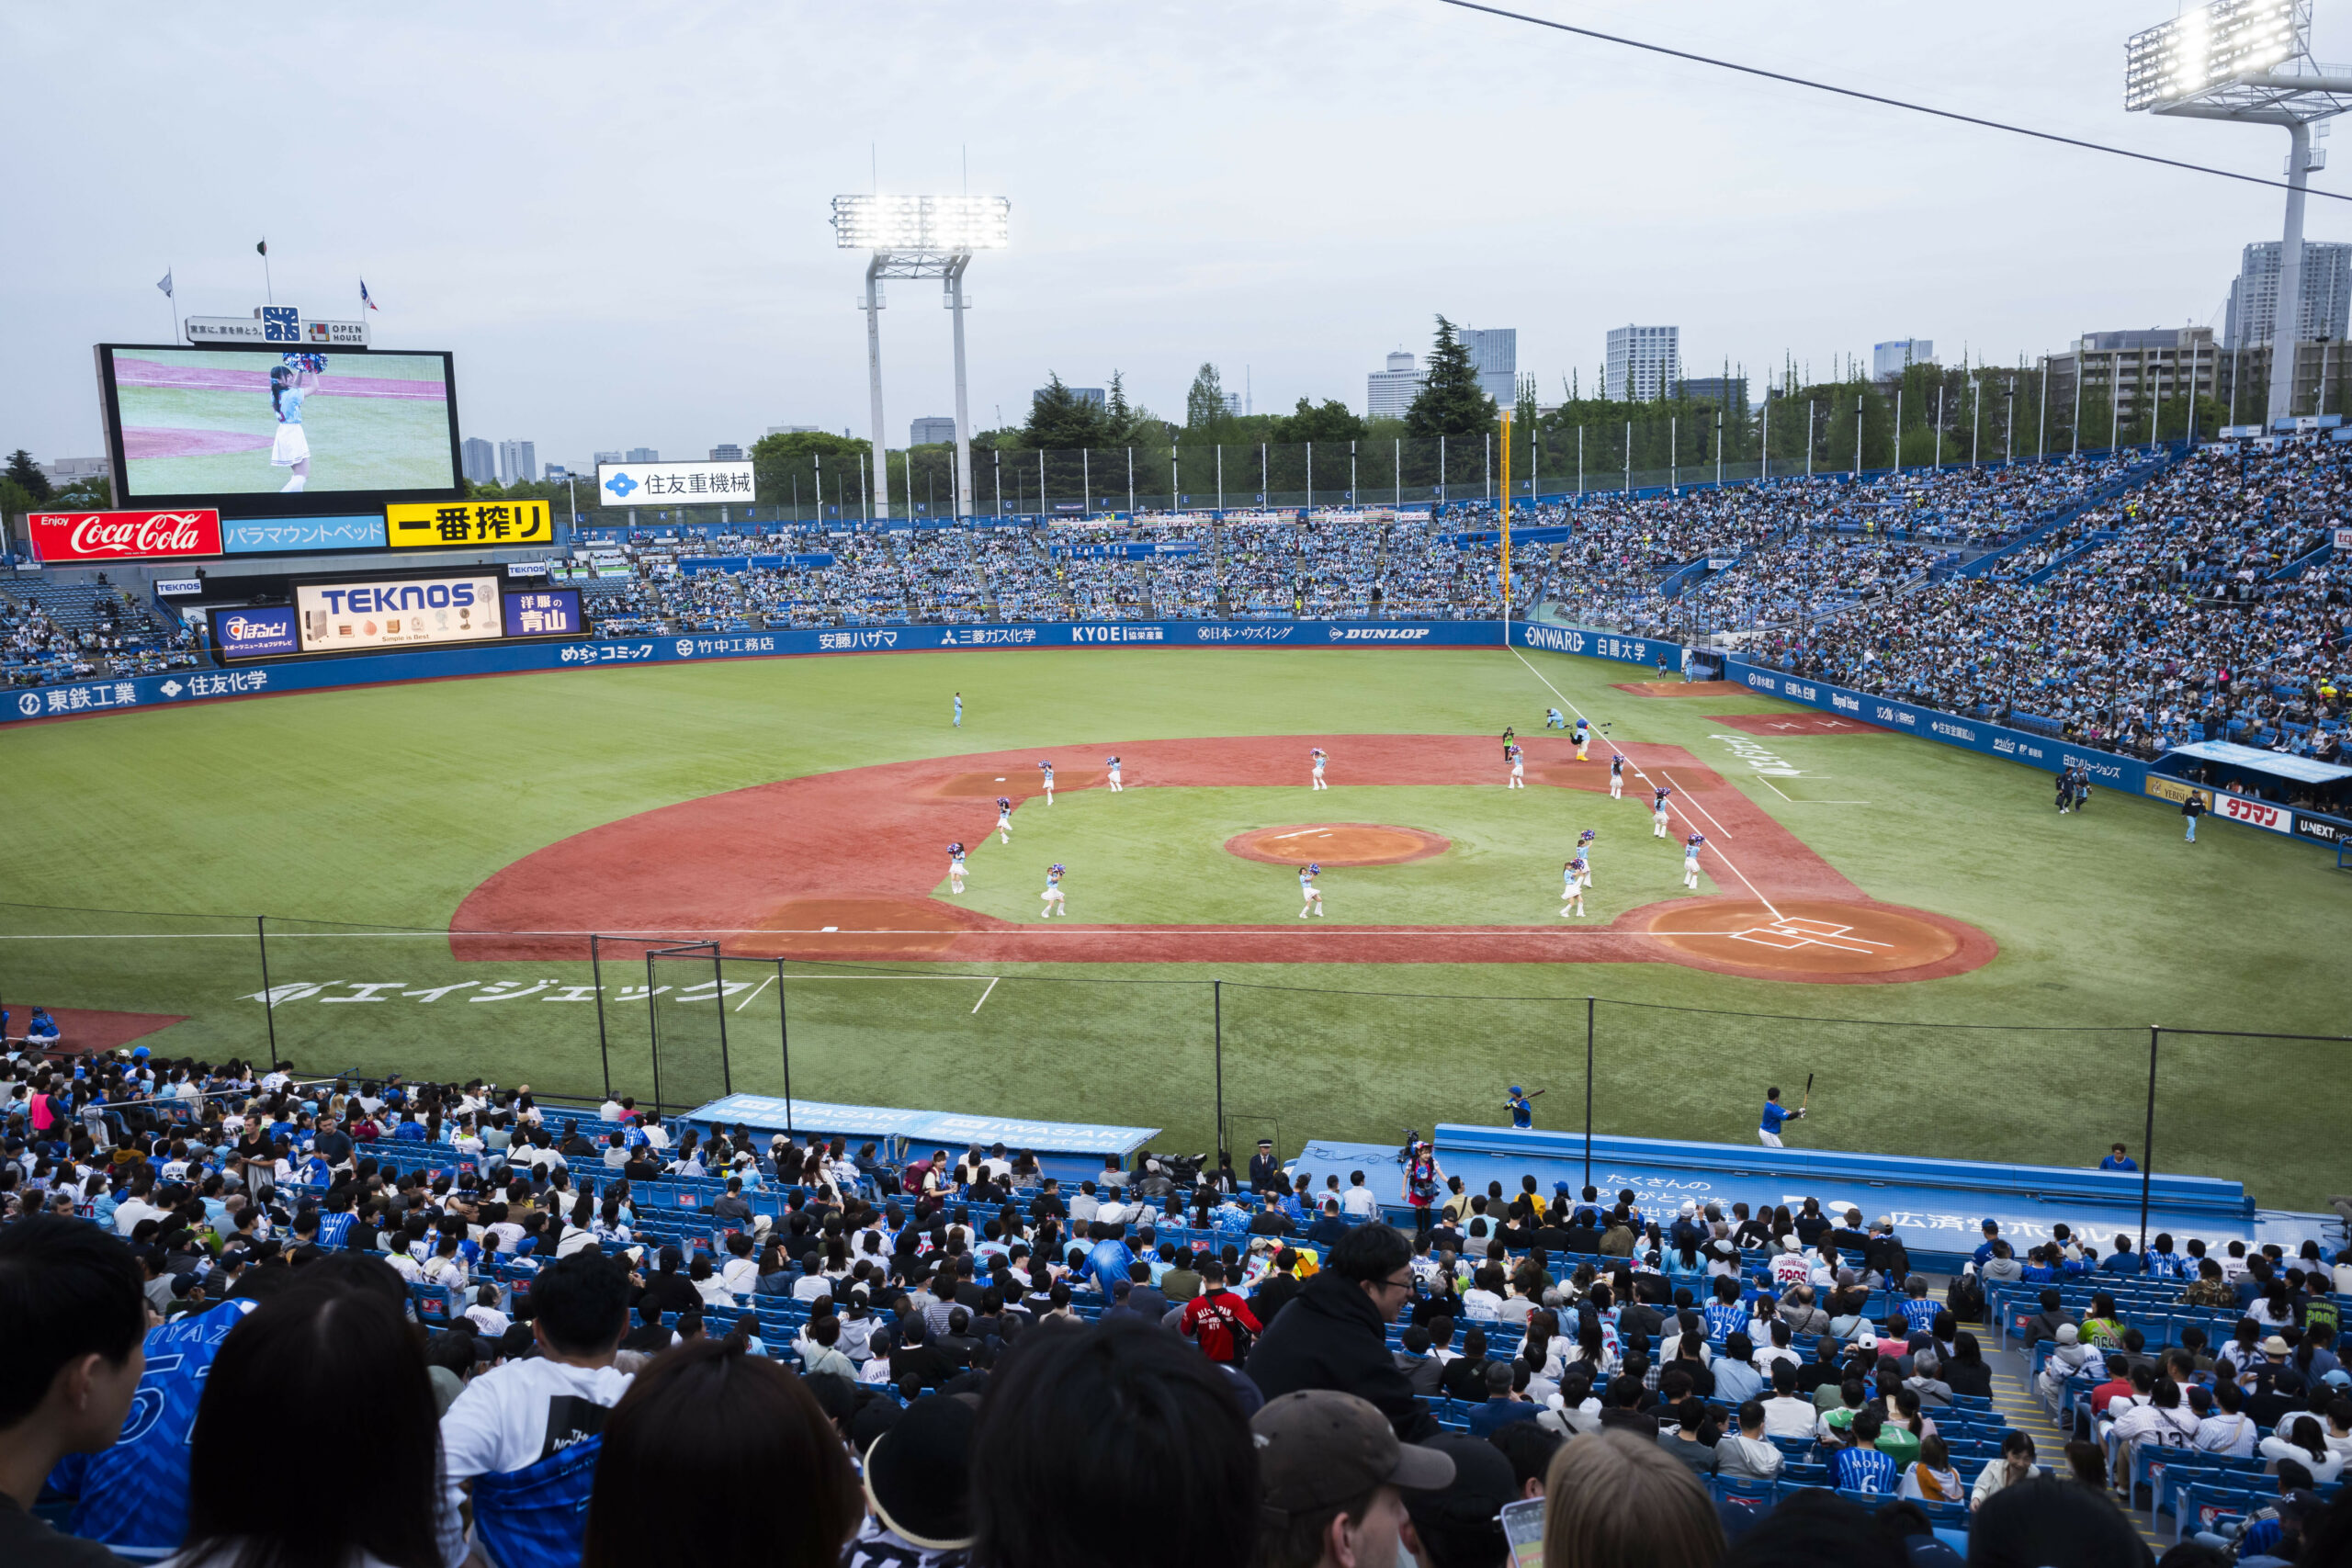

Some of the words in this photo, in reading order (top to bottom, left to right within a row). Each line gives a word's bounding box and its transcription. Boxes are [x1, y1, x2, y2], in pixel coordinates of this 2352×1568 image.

[333, 325, 362, 333] OPEN
[645, 472, 752, 494] 住友重機械
[40, 516, 69, 526] Enjoy
[398, 505, 541, 540] 一番搾り
[71, 513, 202, 554] Coca-Cola
[227, 522, 383, 545] パラマウントベッド
[509, 565, 545, 574] TEKNOS
[157, 582, 200, 592] TEKNOS
[321, 582, 475, 615] TEKNOS
[520, 594, 562, 610] 洋服の
[519, 610, 567, 632] 青山
[381, 635, 402, 643] Simple
[819, 631, 898, 649] 安藤ハザマ
[959, 627, 1036, 644] 三菱ガス化学
[1072, 626, 1128, 642] KYOEI
[1128, 630, 1163, 640] 協栄産業
[1210, 626, 1294, 641] 日本ハウズイング
[1345, 627, 1430, 639] DUNLOP
[1524, 626, 1585, 652] ONWARD
[560, 643, 653, 664] めちゃコミック
[697, 637, 775, 654] 竹中工務店
[187, 670, 267, 696] 住友化学
[46, 682, 136, 712] 東鉄工業
[1832, 693, 1847, 711] Royal
[1847, 695, 1860, 711] Host
[2063, 753, 2121, 779] 日立ソリューションズ
[2226, 798, 2278, 827] タフマン
[319, 979, 755, 1003] エイジェック
[776, 1105, 913, 1122] IWASAKI
[989, 1122, 1135, 1140] IWASAKI
[1606, 1173, 1712, 1191] たくさんの
[324, 1226, 335, 1244] 7
[1741, 1232, 1763, 1249] 17
[2154, 1261, 2175, 1277] 14
[2155, 1430, 2184, 1449] 13
[1851, 1460, 1886, 1472] MORI
[1860, 1474, 1879, 1494] 6
